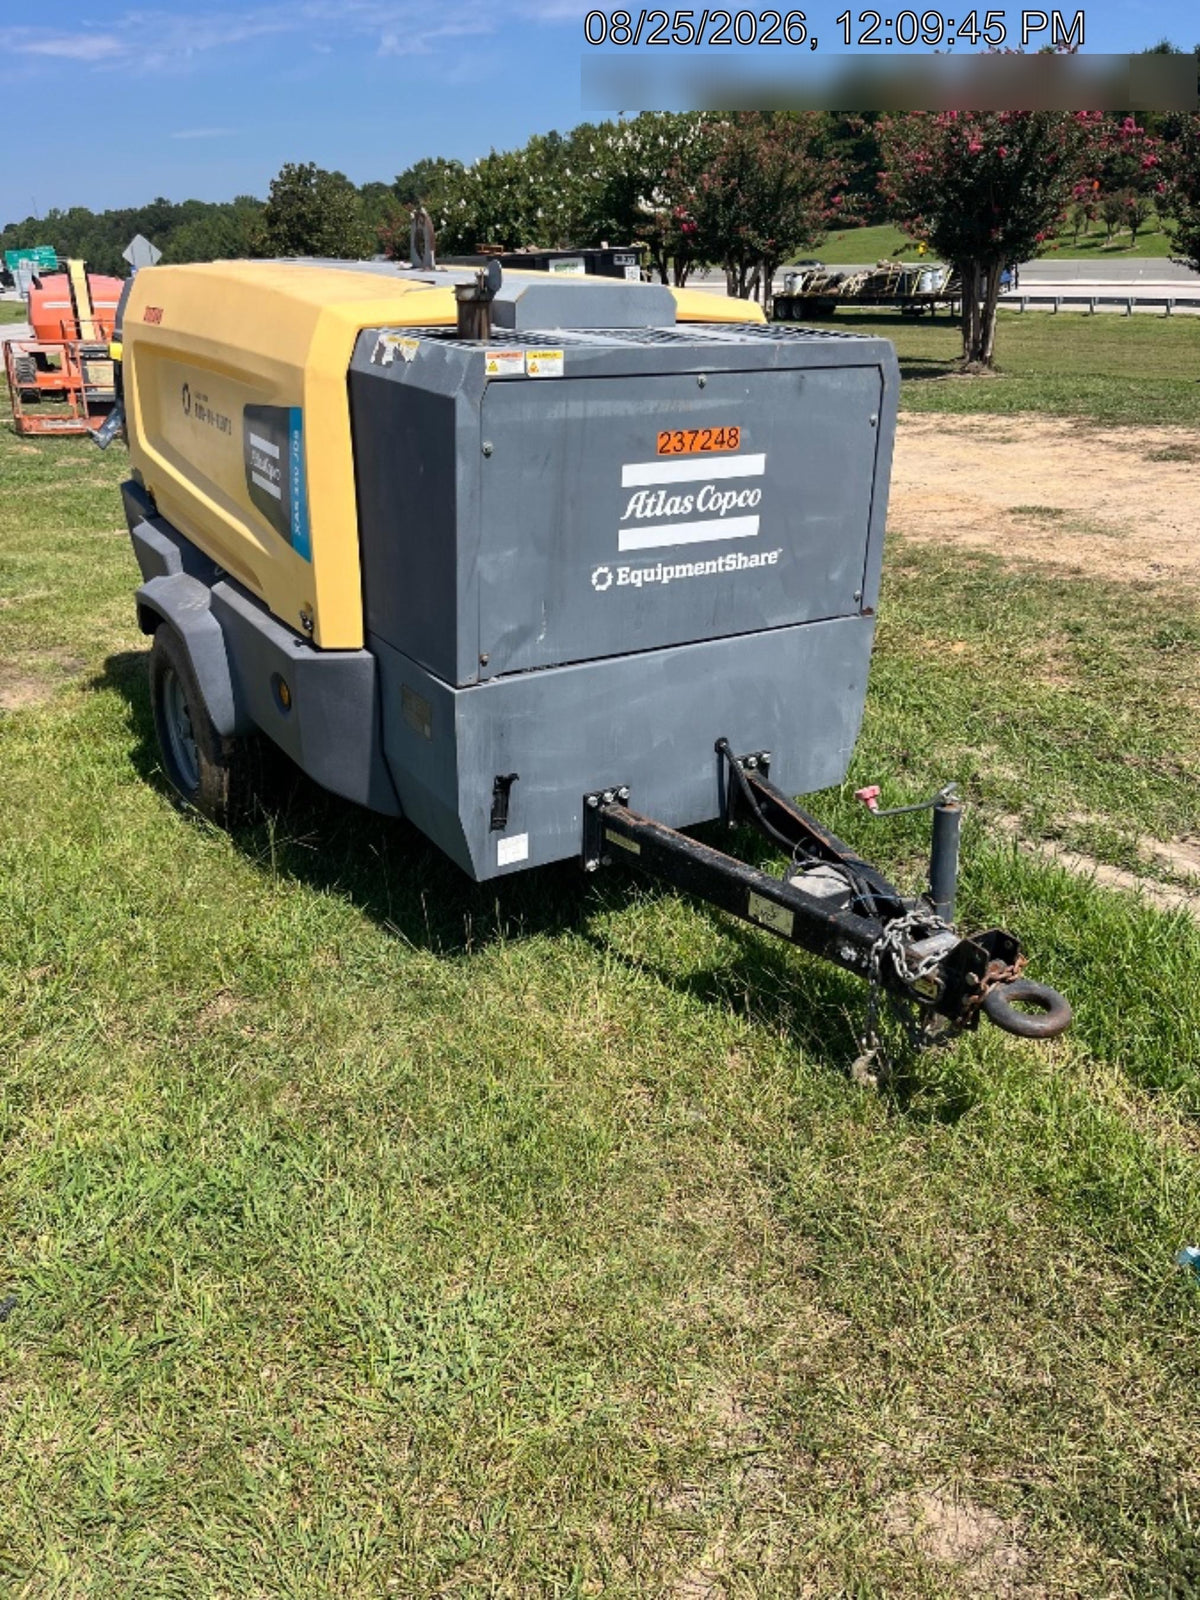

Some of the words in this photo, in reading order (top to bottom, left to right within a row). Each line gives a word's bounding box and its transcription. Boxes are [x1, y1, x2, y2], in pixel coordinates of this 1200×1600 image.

[659, 427, 739, 454] 237248
[620, 489, 695, 520] Atlas
[696, 484, 763, 517] Copco
[616, 549, 779, 588] EquipmentShare
